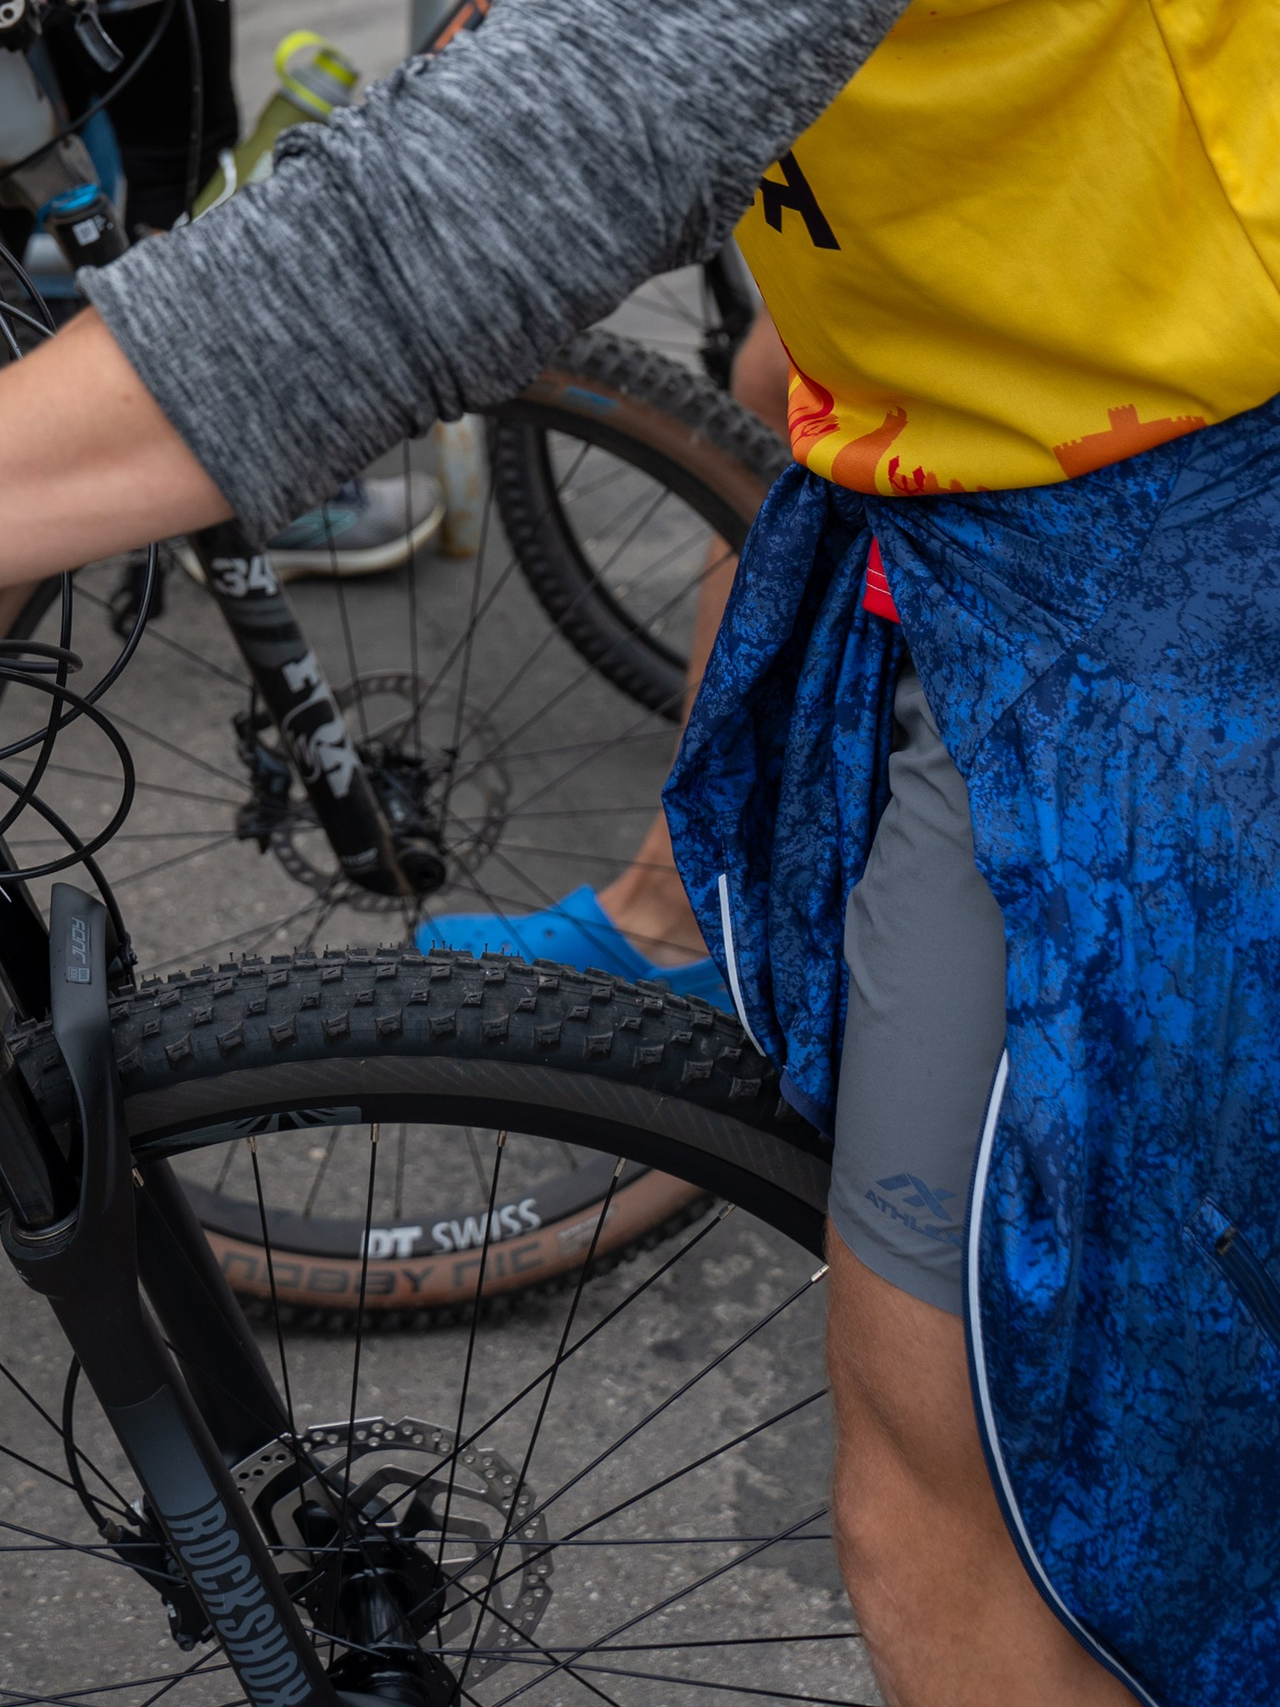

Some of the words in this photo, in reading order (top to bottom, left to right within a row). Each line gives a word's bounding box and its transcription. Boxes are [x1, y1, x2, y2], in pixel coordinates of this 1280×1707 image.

[211, 553, 278, 598] 34
[69, 916, 87, 966] JUDY
[360, 1225, 424, 1261] DT
[430, 1197, 543, 1255] SWISS
[165, 1500, 313, 1707] ROCKSHOX
